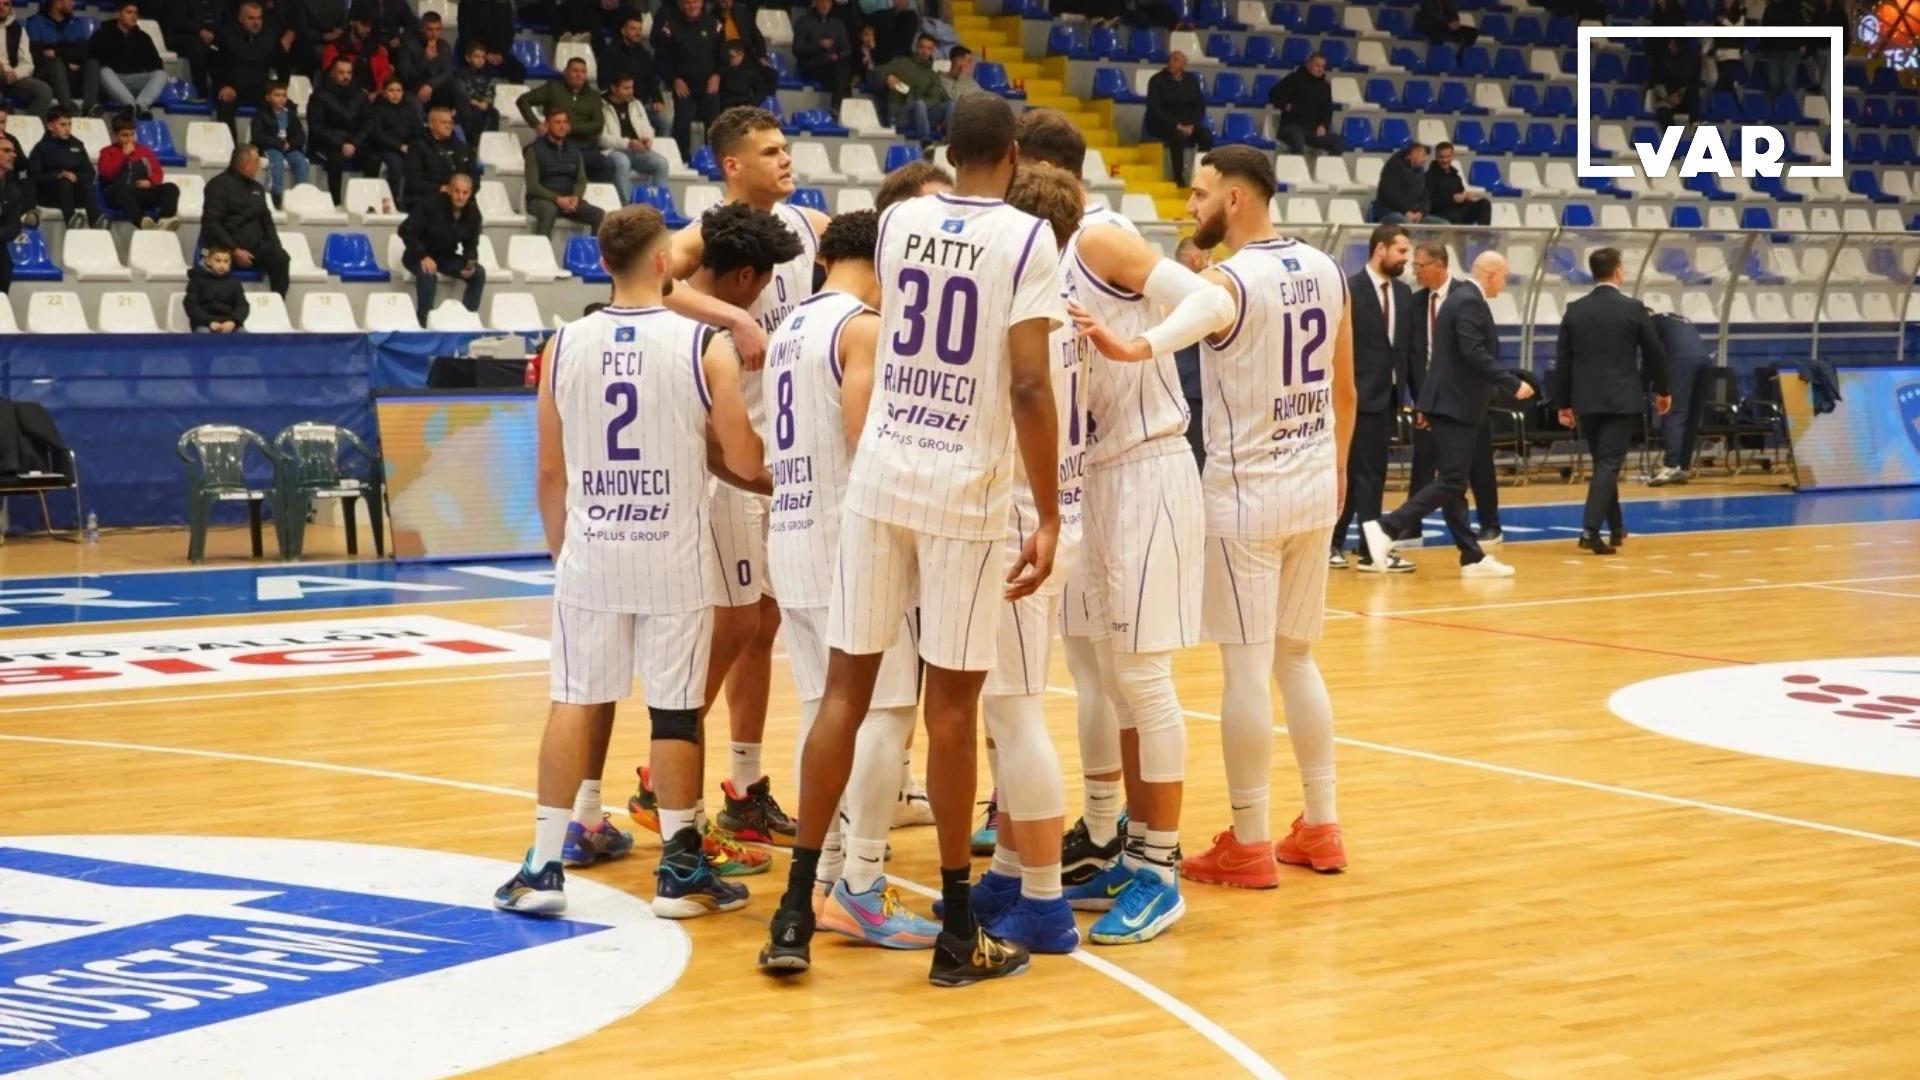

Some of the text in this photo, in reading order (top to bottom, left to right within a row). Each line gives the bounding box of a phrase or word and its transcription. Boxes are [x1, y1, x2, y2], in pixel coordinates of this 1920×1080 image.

[904, 234, 984, 271] PATTY
[1279, 278, 1321, 306] EJUPI
[893, 268, 978, 366] 30
[1283, 307, 1328, 387] 12
[602, 351, 643, 376] PECI
[605, 381, 641, 461] 2
[776, 370, 796, 450] 8
[918, 437, 963, 454] GROUP
[582, 469, 670, 496] RAHOVECI
[588, 503, 670, 522] Orllati
[597, 530, 670, 542] PLUS GROUP
[737, 559, 752, 587] 0
